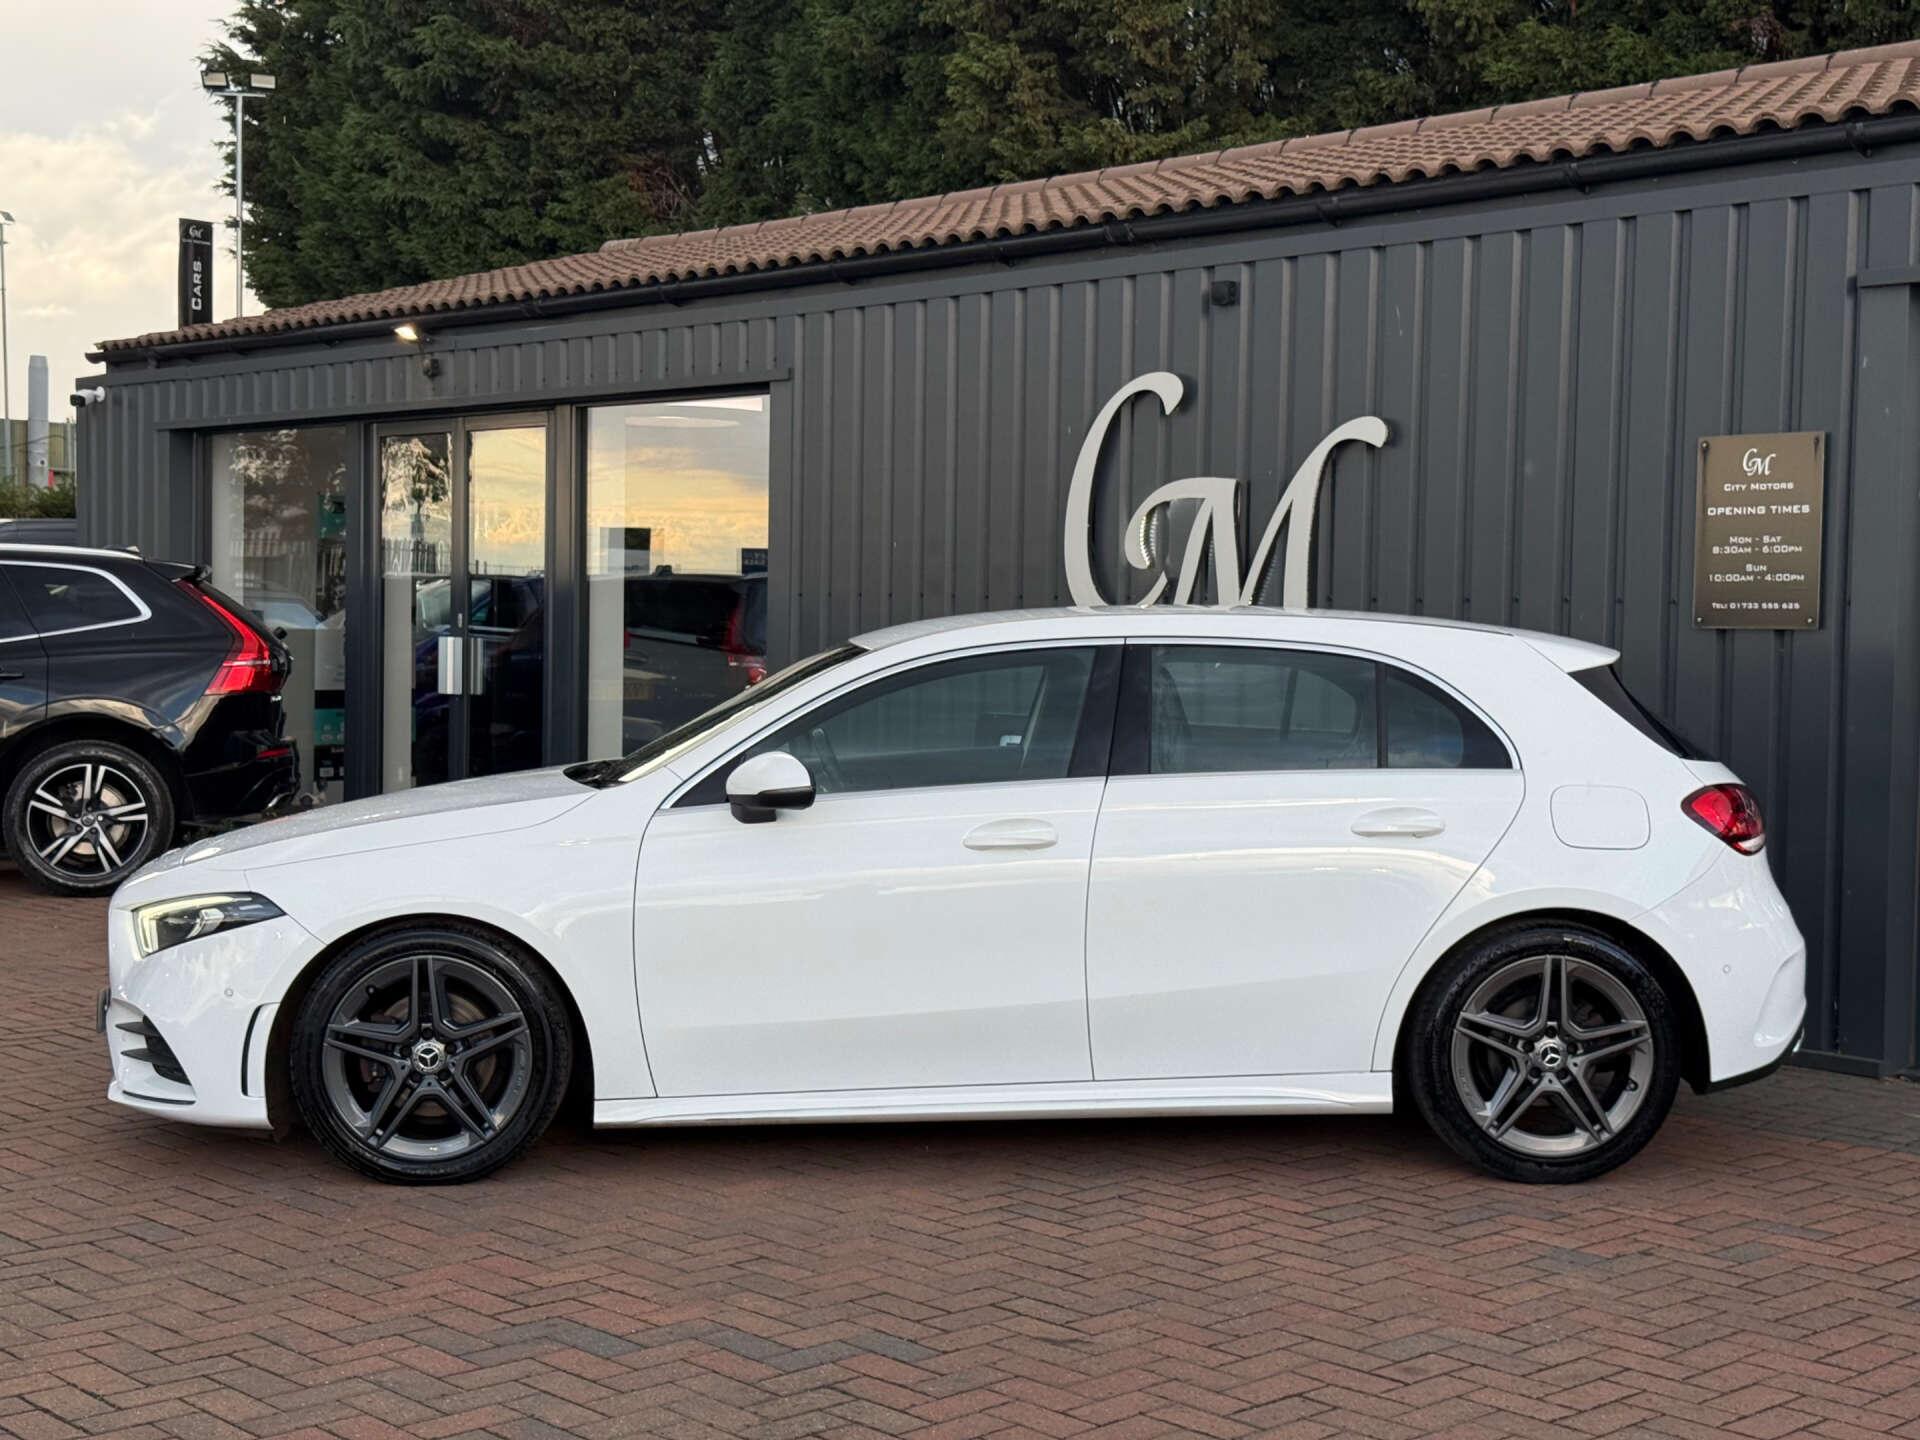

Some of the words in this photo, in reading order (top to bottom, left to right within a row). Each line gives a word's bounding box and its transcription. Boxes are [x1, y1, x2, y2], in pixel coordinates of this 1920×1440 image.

[192, 260, 202, 311] CARS
[1723, 483, 1747, 492] CITY
[1750, 482, 1795, 491] MOTORS
[1707, 505, 1767, 516] OPENING
[1769, 504, 1810, 514] TIMES
[1729, 535, 1752, 544] MON
[1763, 535, 1783, 543] SAT
[1712, 546, 1752, 554] 8:30AM
[1762, 545, 1803, 554] 6:00PM
[1745, 563, 1768, 572] SUN
[1708, 573, 1754, 582] 10:00AM
[1764, 573, 1805, 582] 4:00PM
